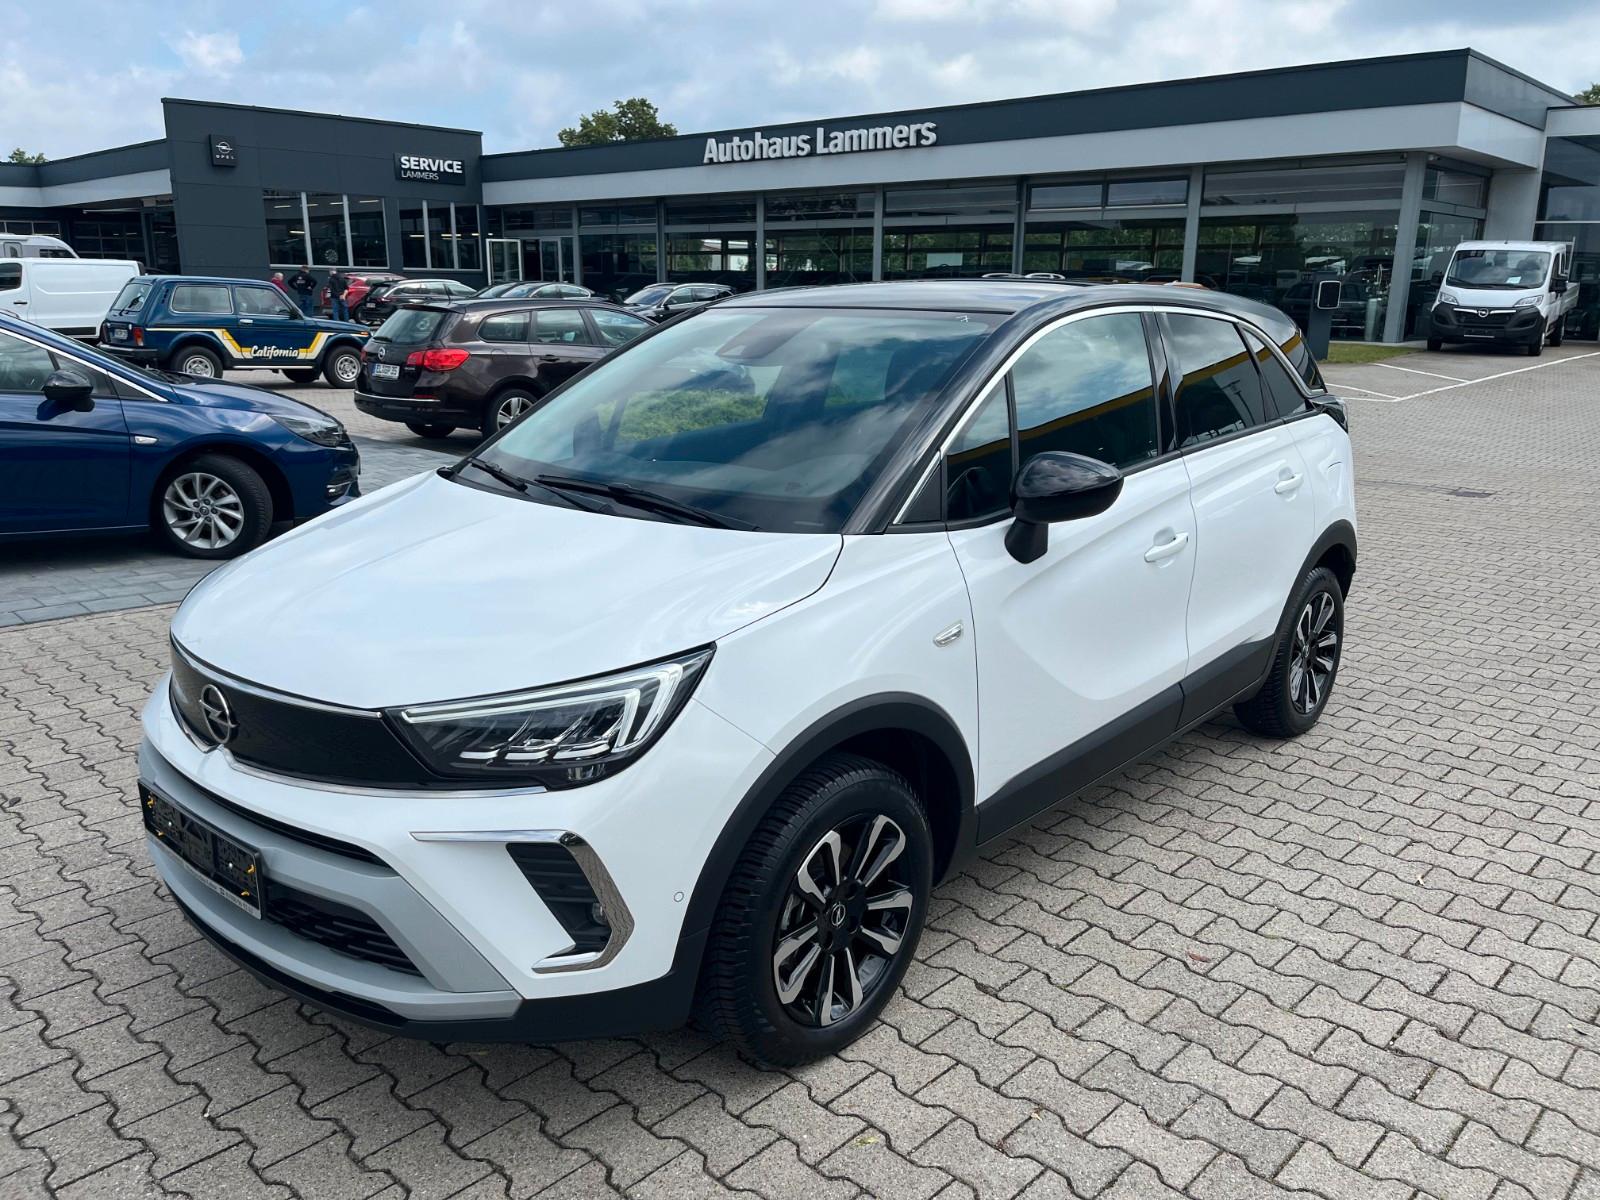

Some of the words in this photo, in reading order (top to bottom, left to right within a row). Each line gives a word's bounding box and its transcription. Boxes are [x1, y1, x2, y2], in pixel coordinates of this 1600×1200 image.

[703, 132, 811, 164] Autohaus
[816, 122, 937, 154] Lammers
[400, 156, 463, 174] SERVICE
[401, 170, 439, 181] LAMMERS
[251, 345, 299, 360] California
